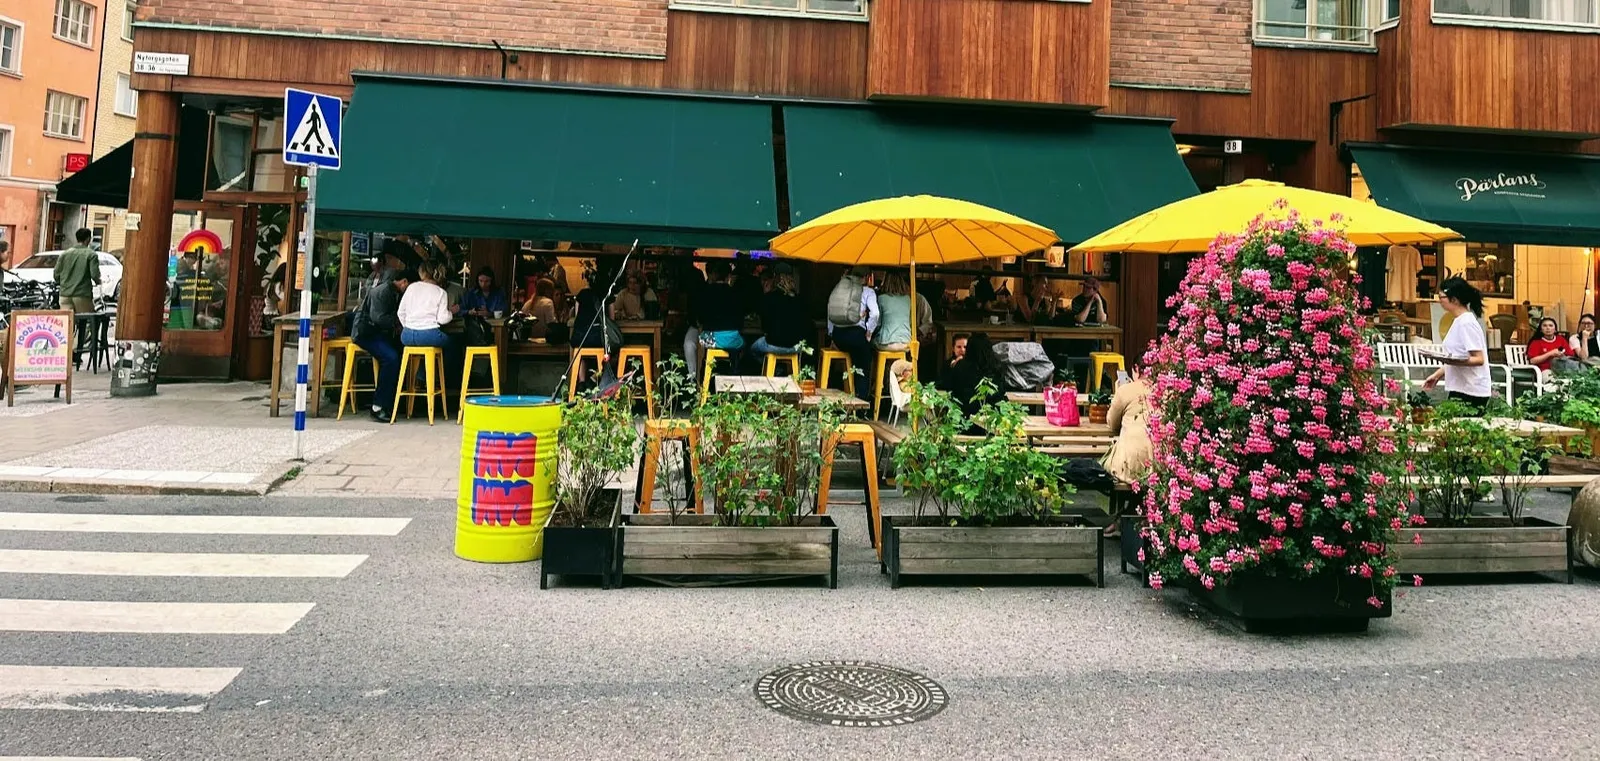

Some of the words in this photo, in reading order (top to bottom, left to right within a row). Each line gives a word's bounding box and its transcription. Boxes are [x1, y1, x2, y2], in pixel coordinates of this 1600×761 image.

[1226, 141, 1237, 151] 38
[69, 156, 86, 168] PS
[1455, 172, 1547, 202] Pärlans
[16, 326, 34, 346] FOOD
[35, 323, 53, 332] ALL
[54, 331, 67, 345] DAY
[28, 356, 66, 366] COFFEE
